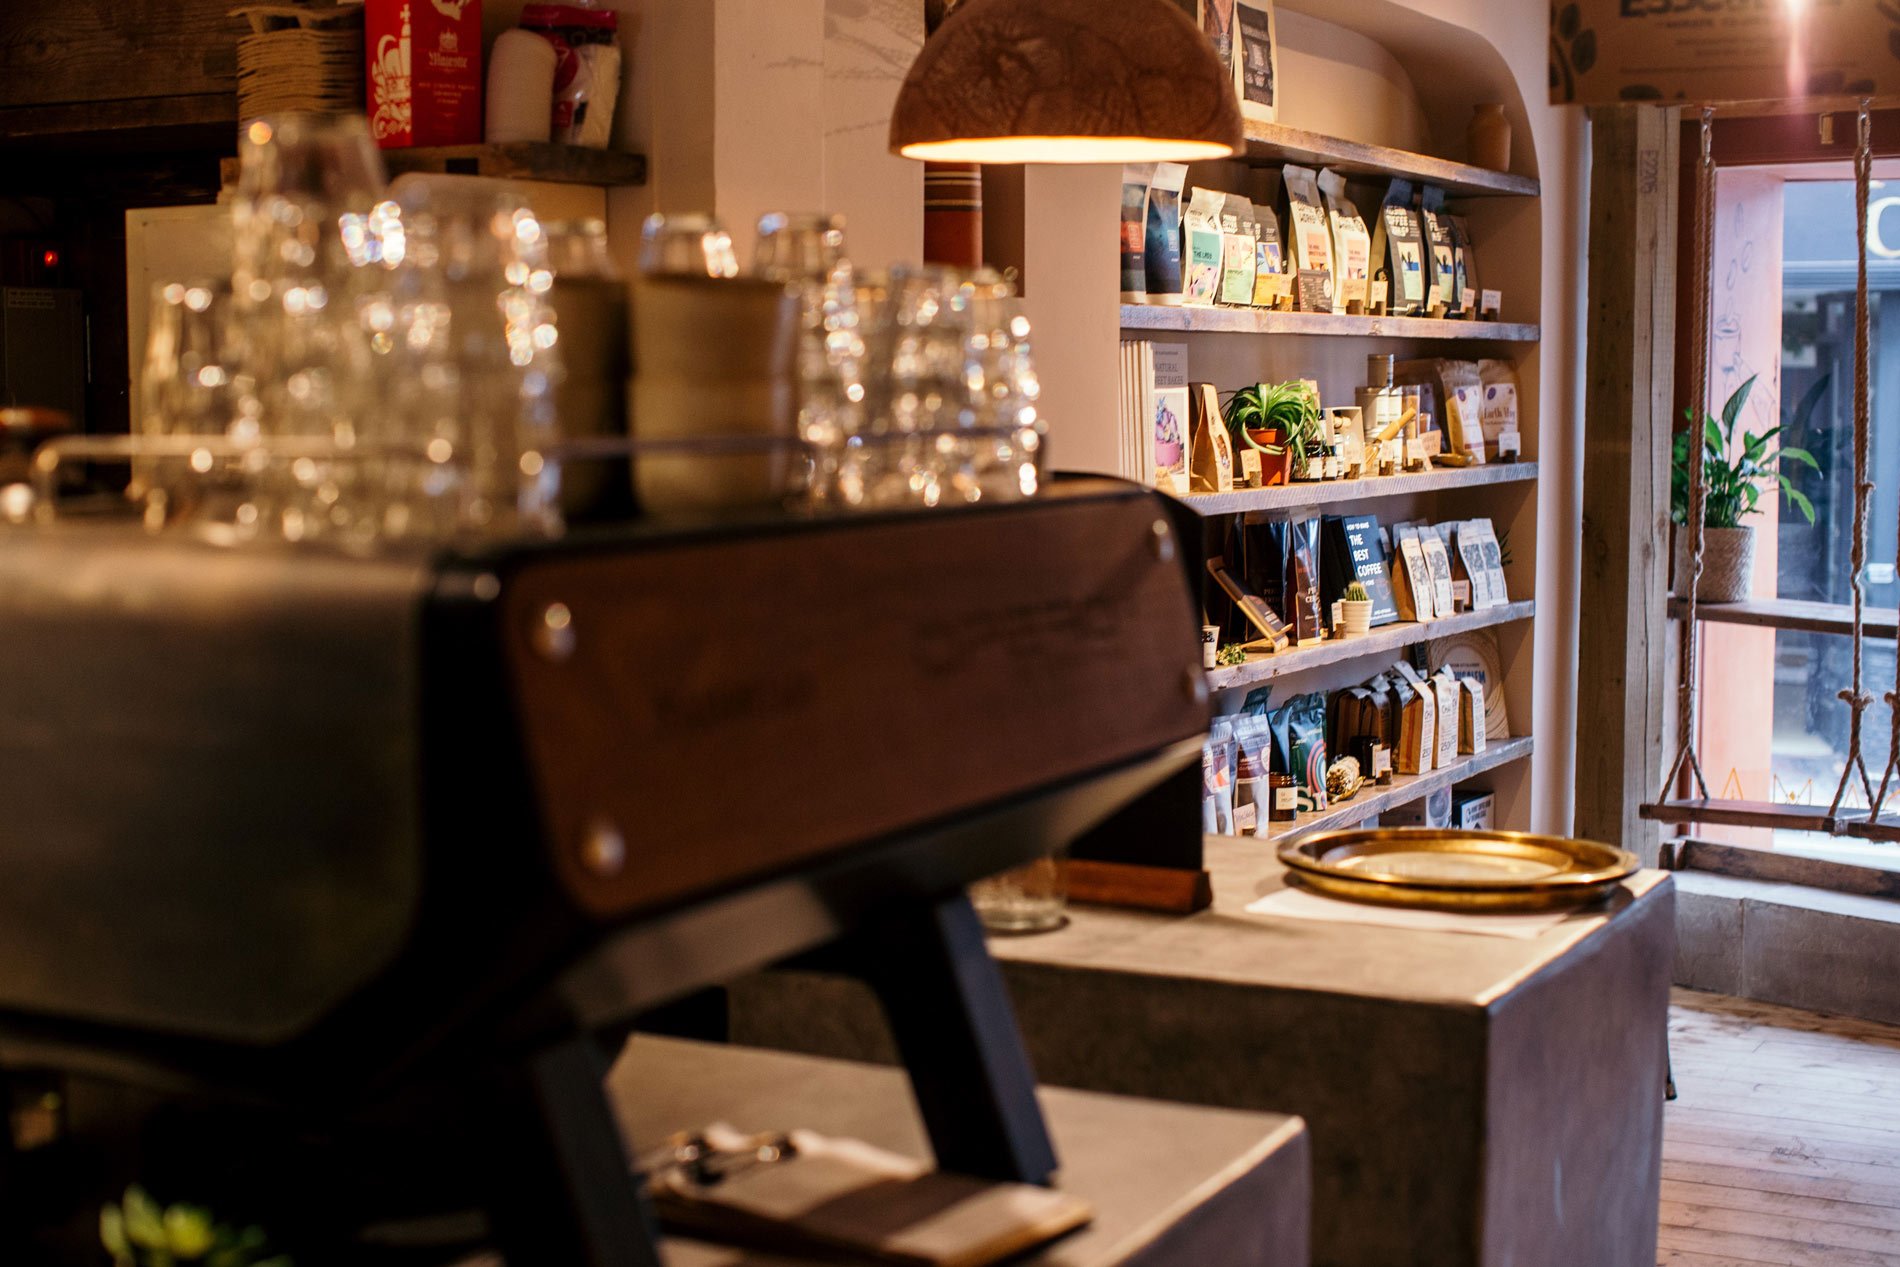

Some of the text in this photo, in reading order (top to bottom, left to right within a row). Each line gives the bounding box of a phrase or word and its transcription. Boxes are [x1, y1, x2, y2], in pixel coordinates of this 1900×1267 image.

[1349, 533, 1363, 546] THE
[1353, 548, 1368, 562] BEST
[1357, 562, 1382, 577] COFFEE
